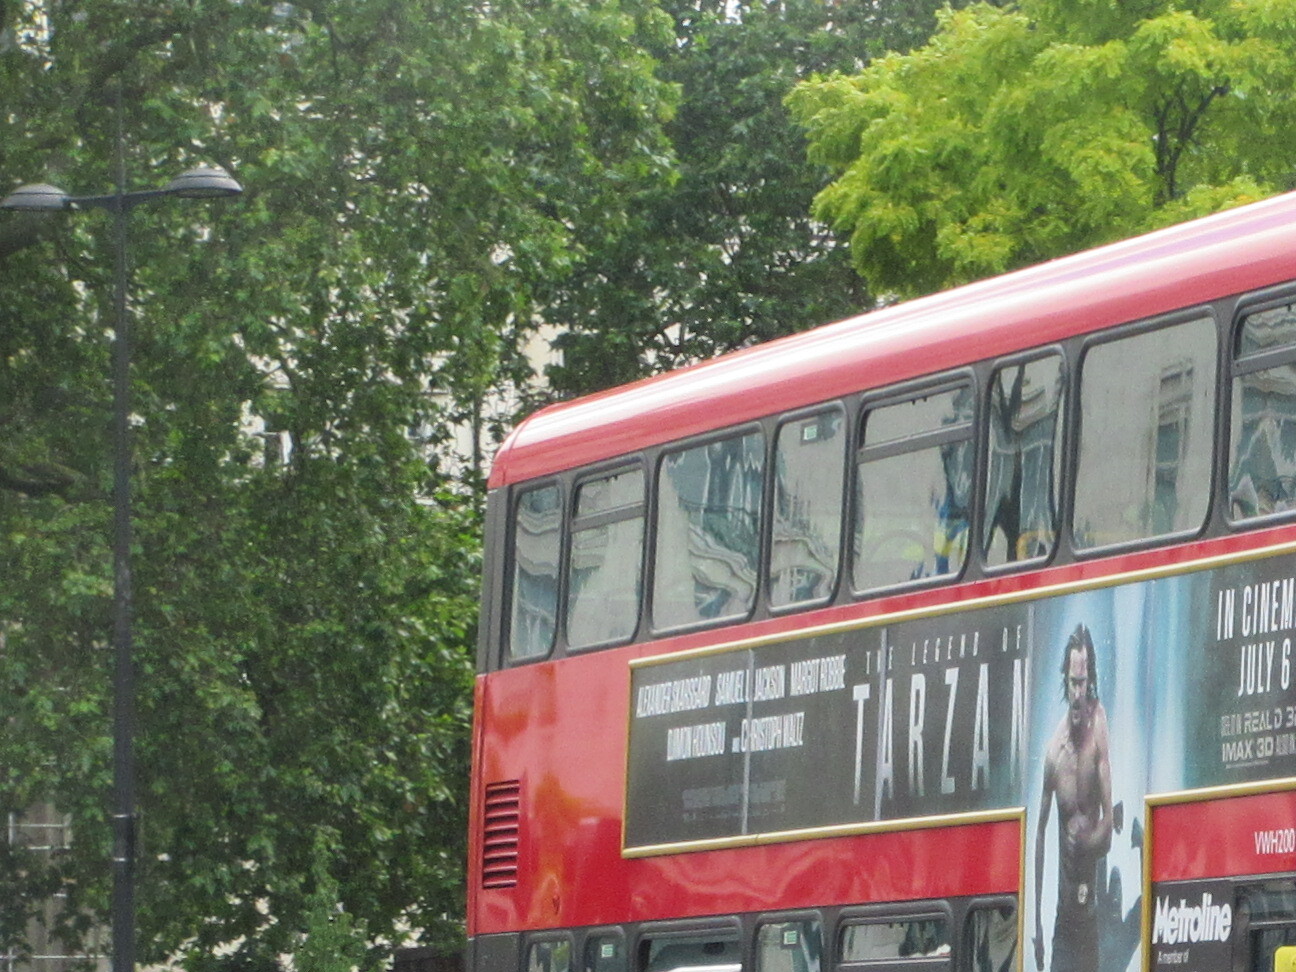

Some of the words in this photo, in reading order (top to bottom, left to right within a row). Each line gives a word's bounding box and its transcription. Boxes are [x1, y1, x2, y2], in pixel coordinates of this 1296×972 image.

[1002, 624, 1023, 653] OF
[1216, 588, 1235, 641] IN
[1237, 641, 1275, 697] JULY
[1280, 637, 1291, 691] 6
[852, 657, 1031, 805] TARZAN
[1151, 892, 1232, 945] Metroline
